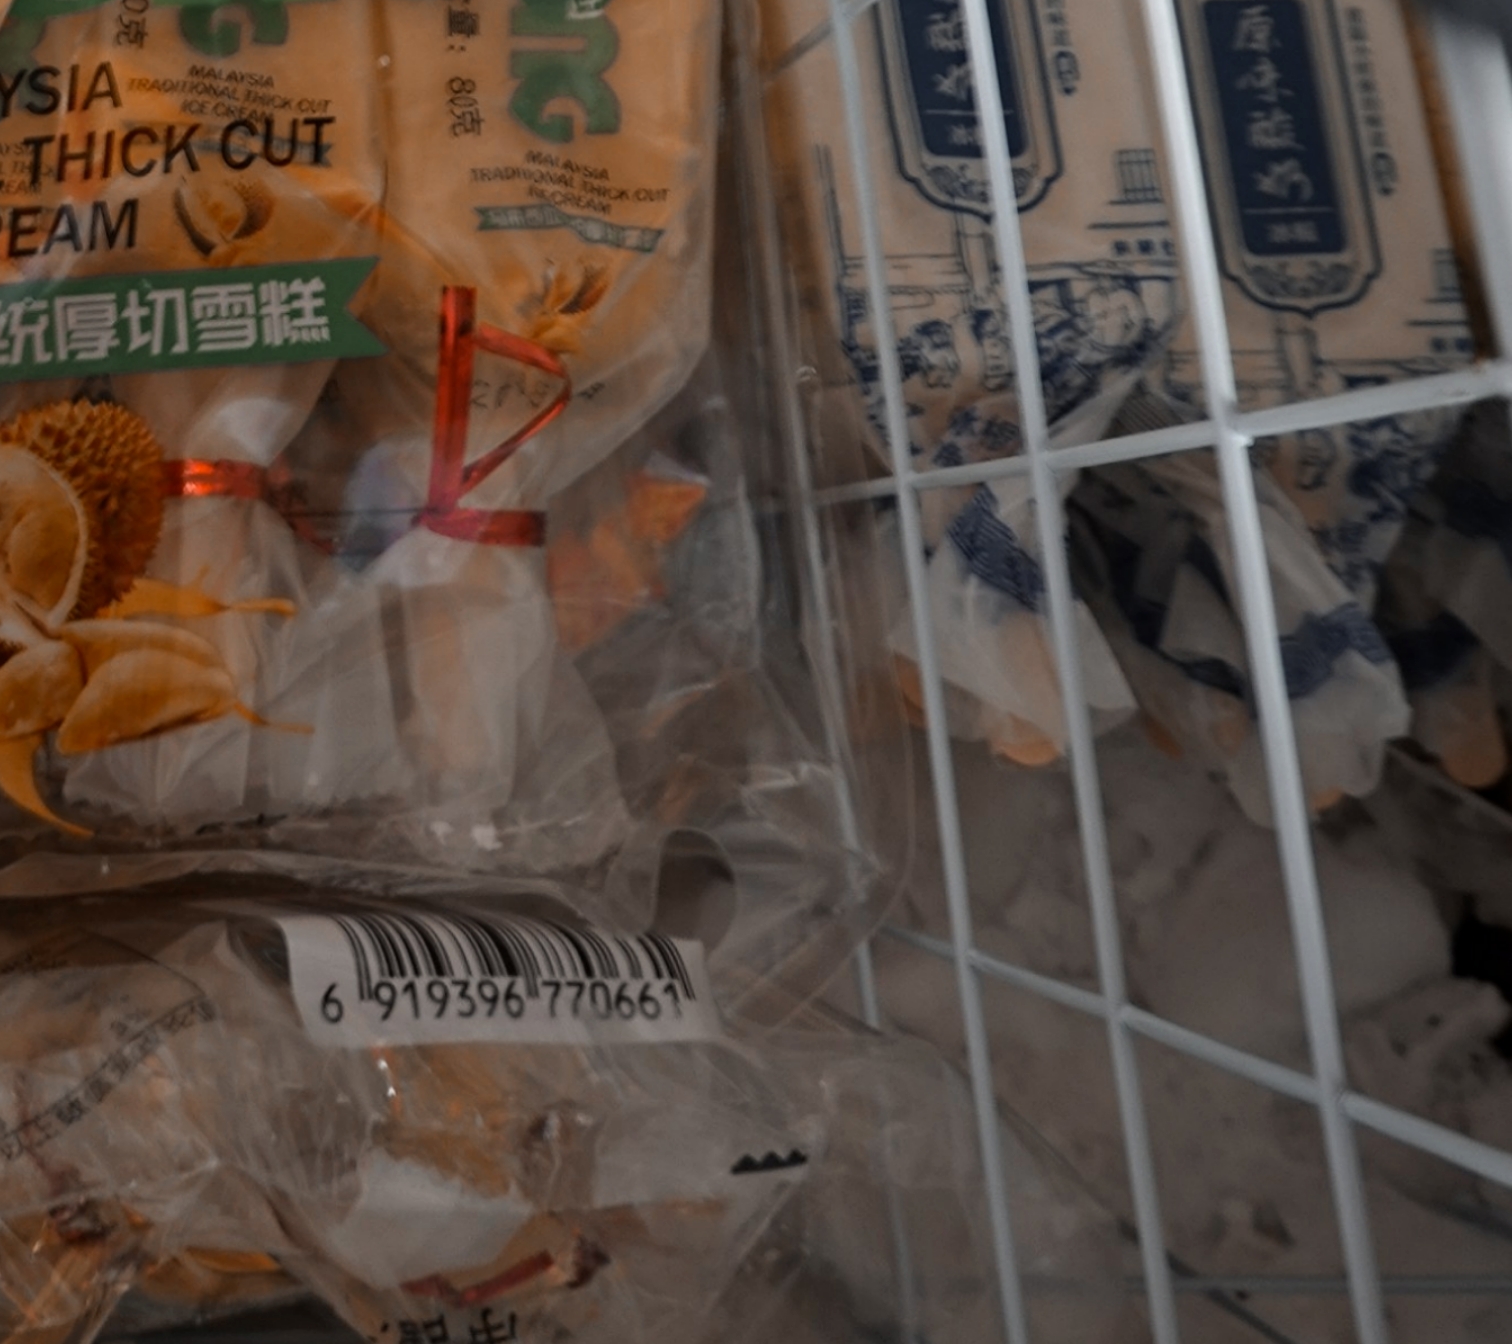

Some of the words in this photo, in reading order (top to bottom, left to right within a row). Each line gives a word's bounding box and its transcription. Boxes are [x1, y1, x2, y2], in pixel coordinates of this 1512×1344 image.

[128, 78, 238, 101] TRADITIONAL
[188, 64, 274, 88] MALAYSIA
[23, 127, 203, 188] THICK
[220, 117, 336, 170] CUT
[321, 983, 345, 1023] 6
[374, 976, 525, 1021] 919396
[539, 976, 683, 1021] 770661
